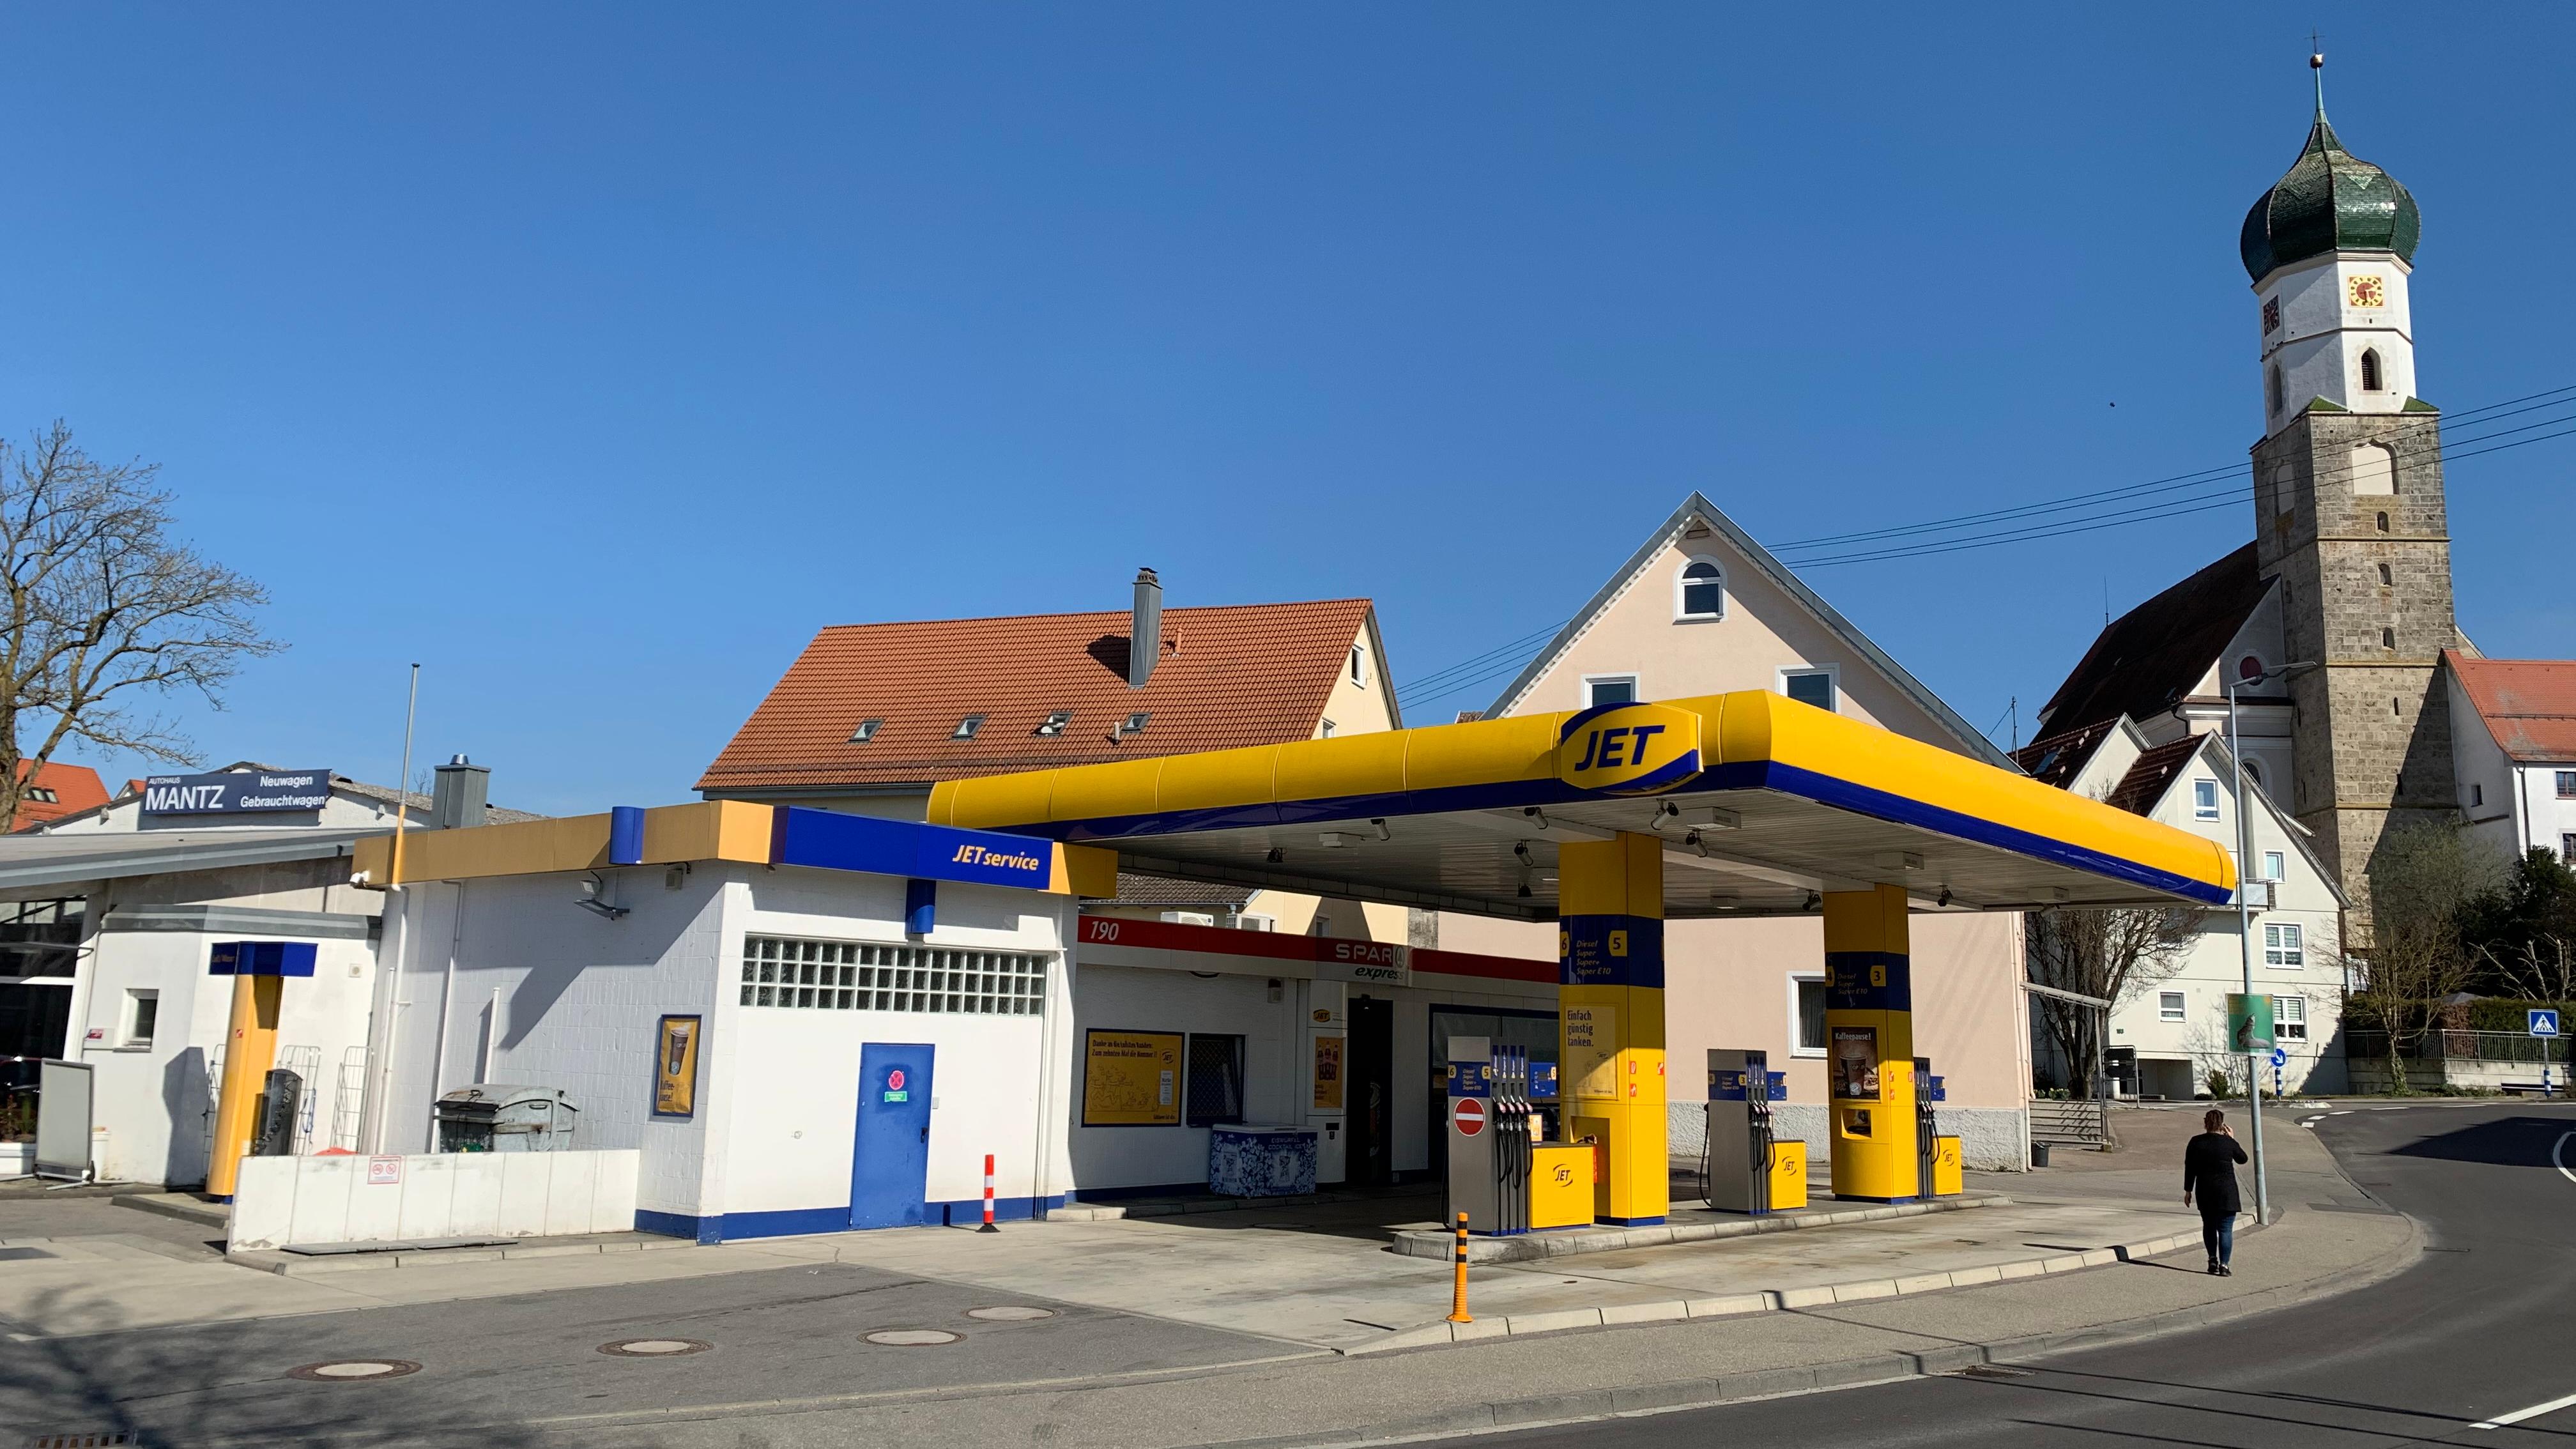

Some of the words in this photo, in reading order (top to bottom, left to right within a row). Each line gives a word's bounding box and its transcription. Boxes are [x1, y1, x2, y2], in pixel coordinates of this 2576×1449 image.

[1574, 725, 1666, 771] JET
[259, 776, 313, 788] Neuwagen
[145, 785, 226, 811] MANTZ
[240, 795, 325, 808] Gebrauchtwagen
[1090, 921, 1119, 941] 190
[1561, 937, 1567, 951] 6
[1613, 937, 1621, 950] 5
[1335, 943, 1392, 963] SPAR
[1576, 949, 1597, 958] Super
[1354, 966, 1404, 980] express
[1576, 967, 1596, 977] Super
[1873, 970, 1881, 981] 3
[1567, 1010, 1591, 1020] Einfach
[1567, 1023, 1593, 1036] günstig
[1568, 1036, 1594, 1046] tanken.
[1835, 1032, 1871, 1041] Kaffeepause!
[1449, 1068, 1454, 1076] 6
[1484, 1068, 1489, 1077] 5
[1944, 1153, 1953, 1163] JET
[1783, 1161, 1795, 1171] JET
[1554, 1170, 1571, 1181] JET
